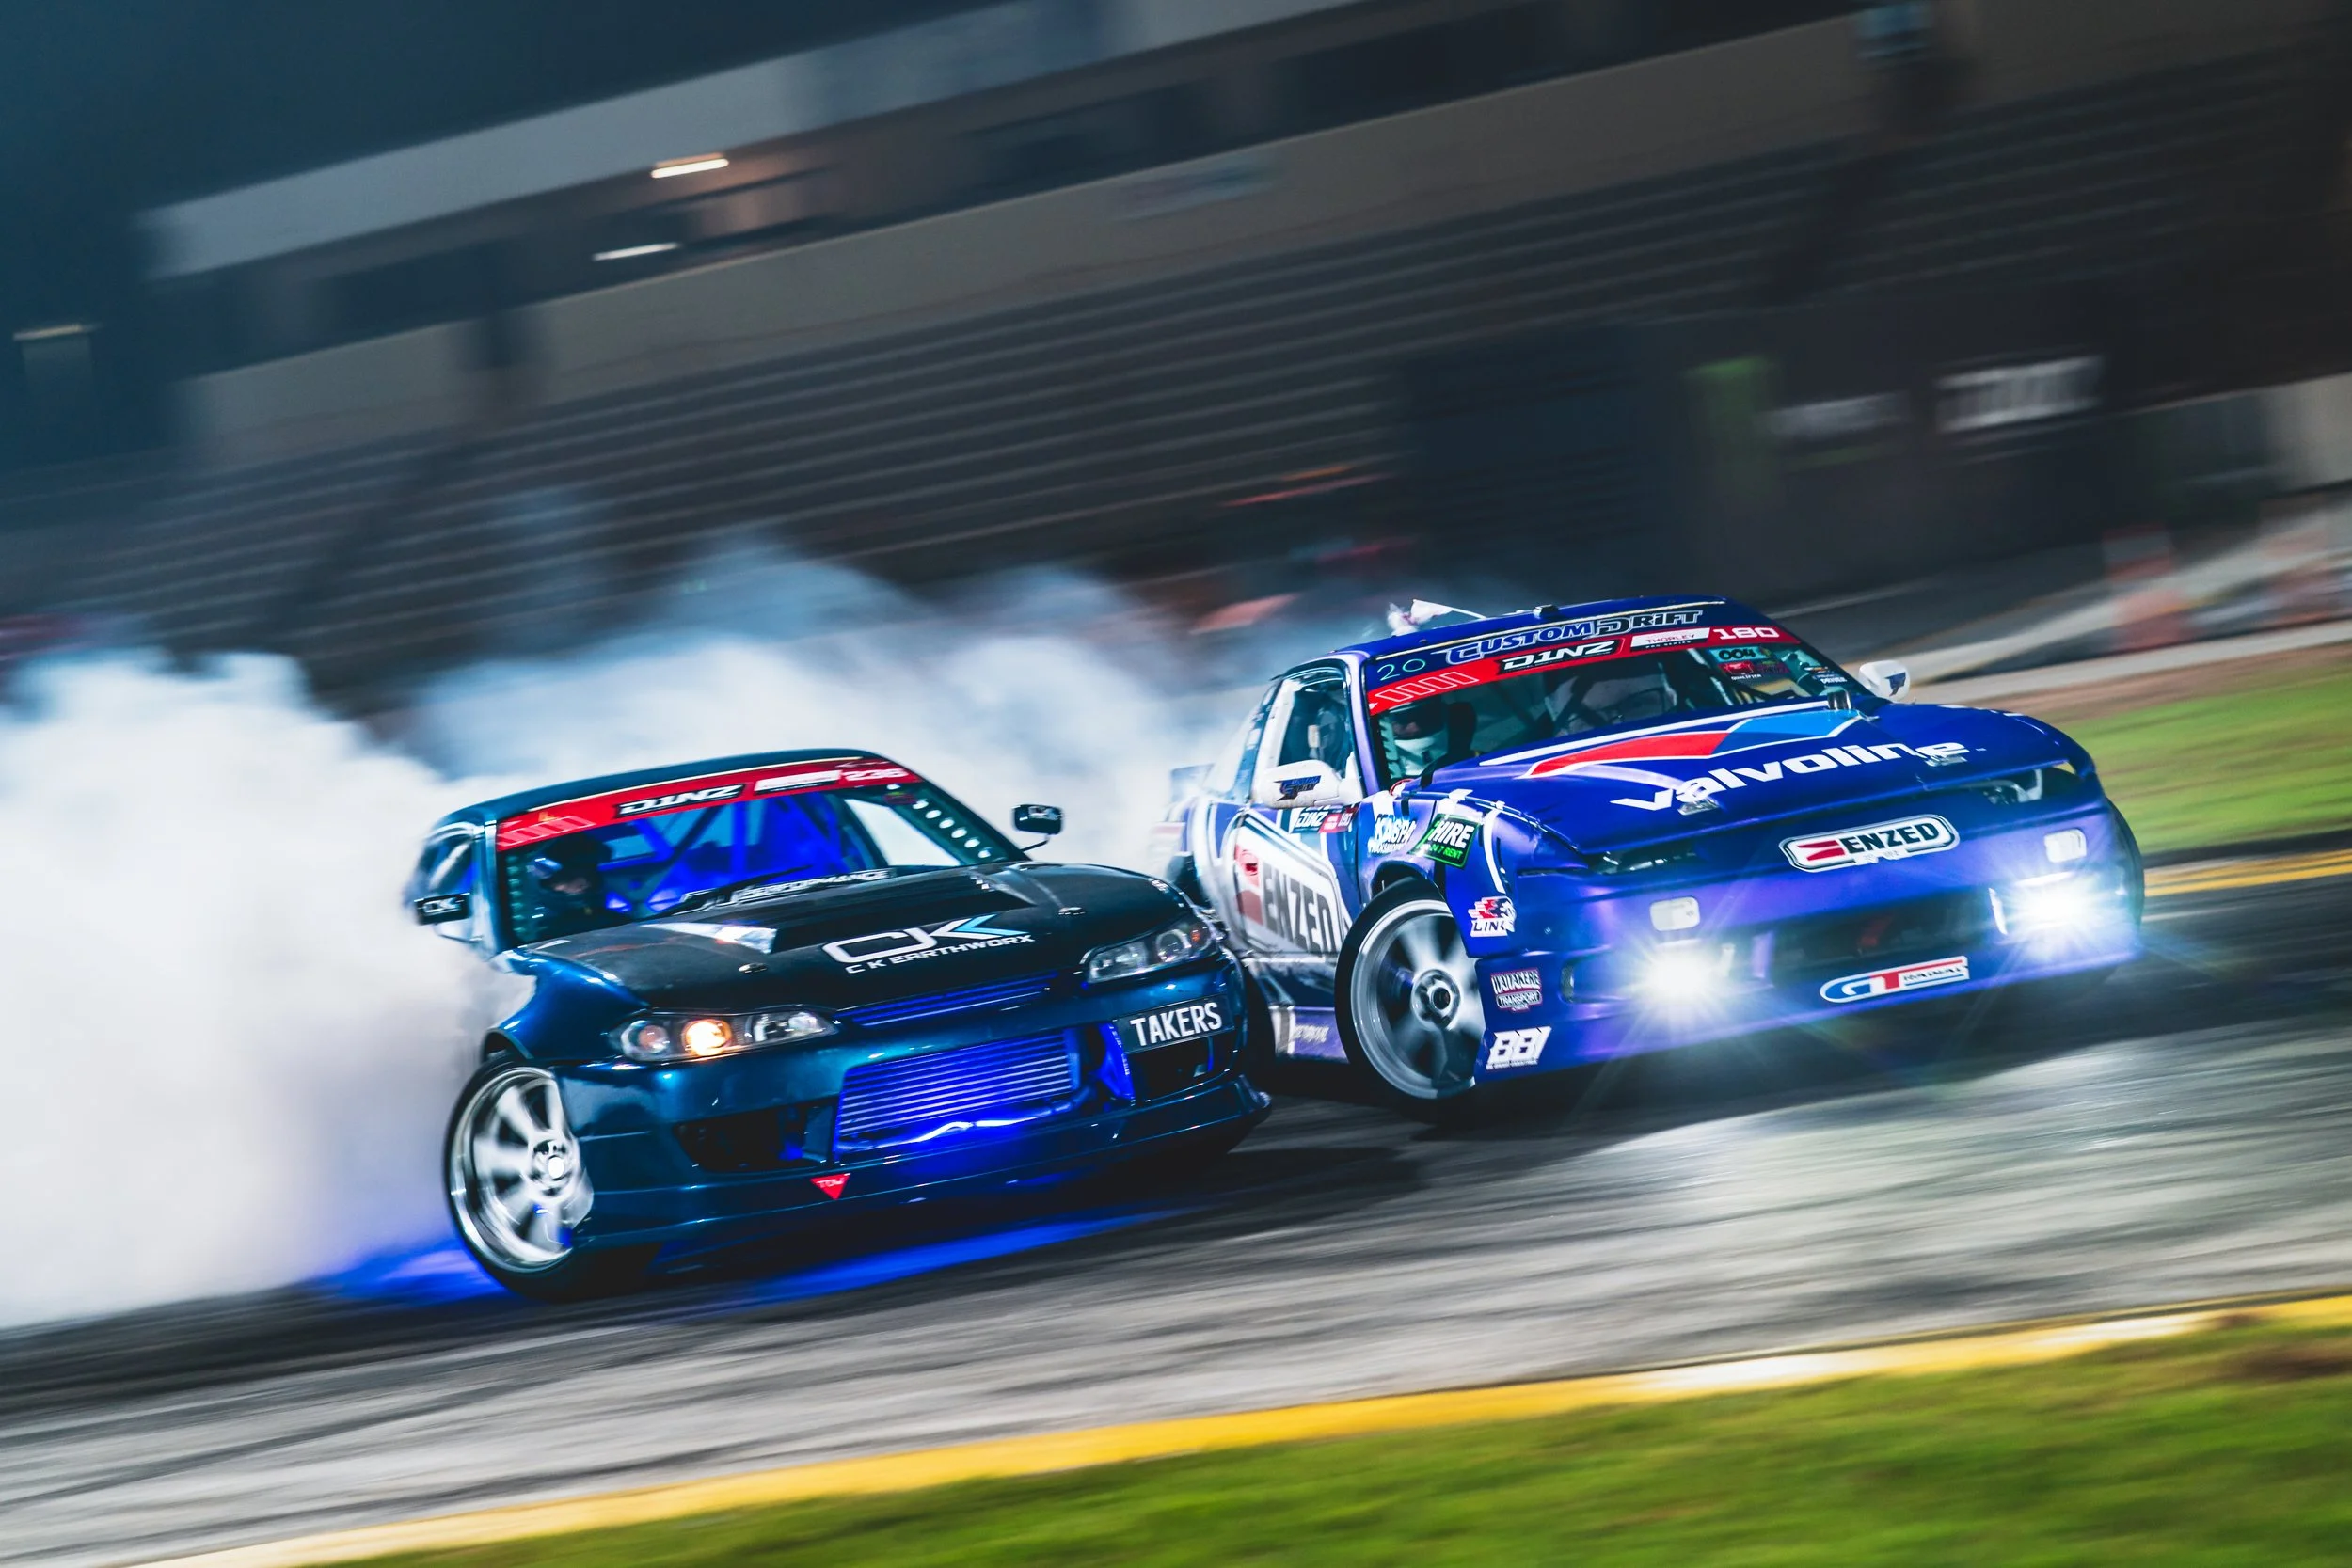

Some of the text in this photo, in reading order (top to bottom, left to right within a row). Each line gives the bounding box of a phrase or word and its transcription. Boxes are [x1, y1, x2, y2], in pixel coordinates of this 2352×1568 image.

[1713, 627, 1780, 640] 180
[1504, 641, 1614, 670] D1NZ
[1718, 649, 1756, 660] 004
[1377, 658, 1426, 681] 20
[1428, 820, 1474, 848] HIRE
[1839, 823, 1940, 854] ENZED
[1263, 862, 1337, 954] ENZED
[889, 935, 1035, 964] EARTHWORX
[1130, 1002, 1222, 1046] TAKERS
